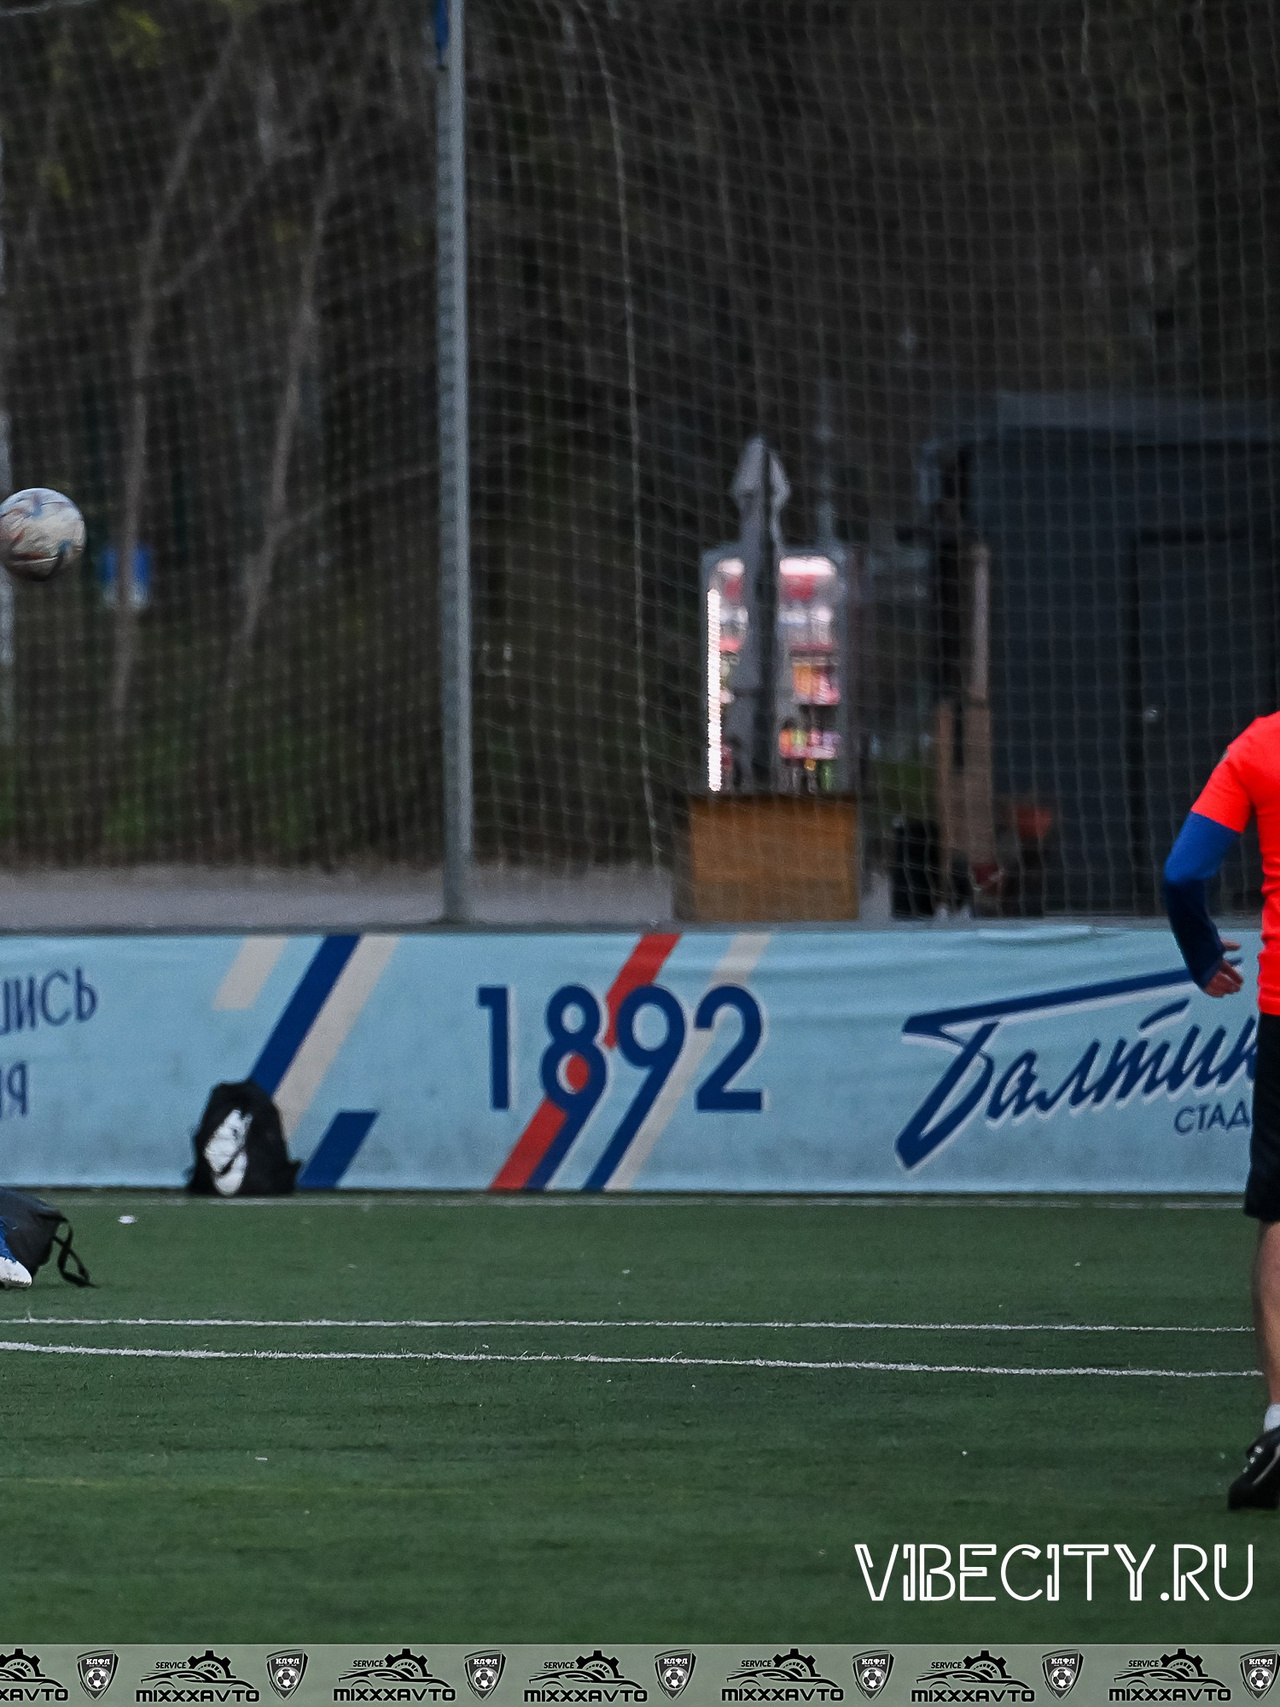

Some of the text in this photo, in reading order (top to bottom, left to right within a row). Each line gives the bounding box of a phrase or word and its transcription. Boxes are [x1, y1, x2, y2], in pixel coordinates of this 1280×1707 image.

[477, 983, 762, 1190] 1892
[895, 957, 1258, 1169] Балтик
[1174, 1100, 1252, 1134] СТАД
